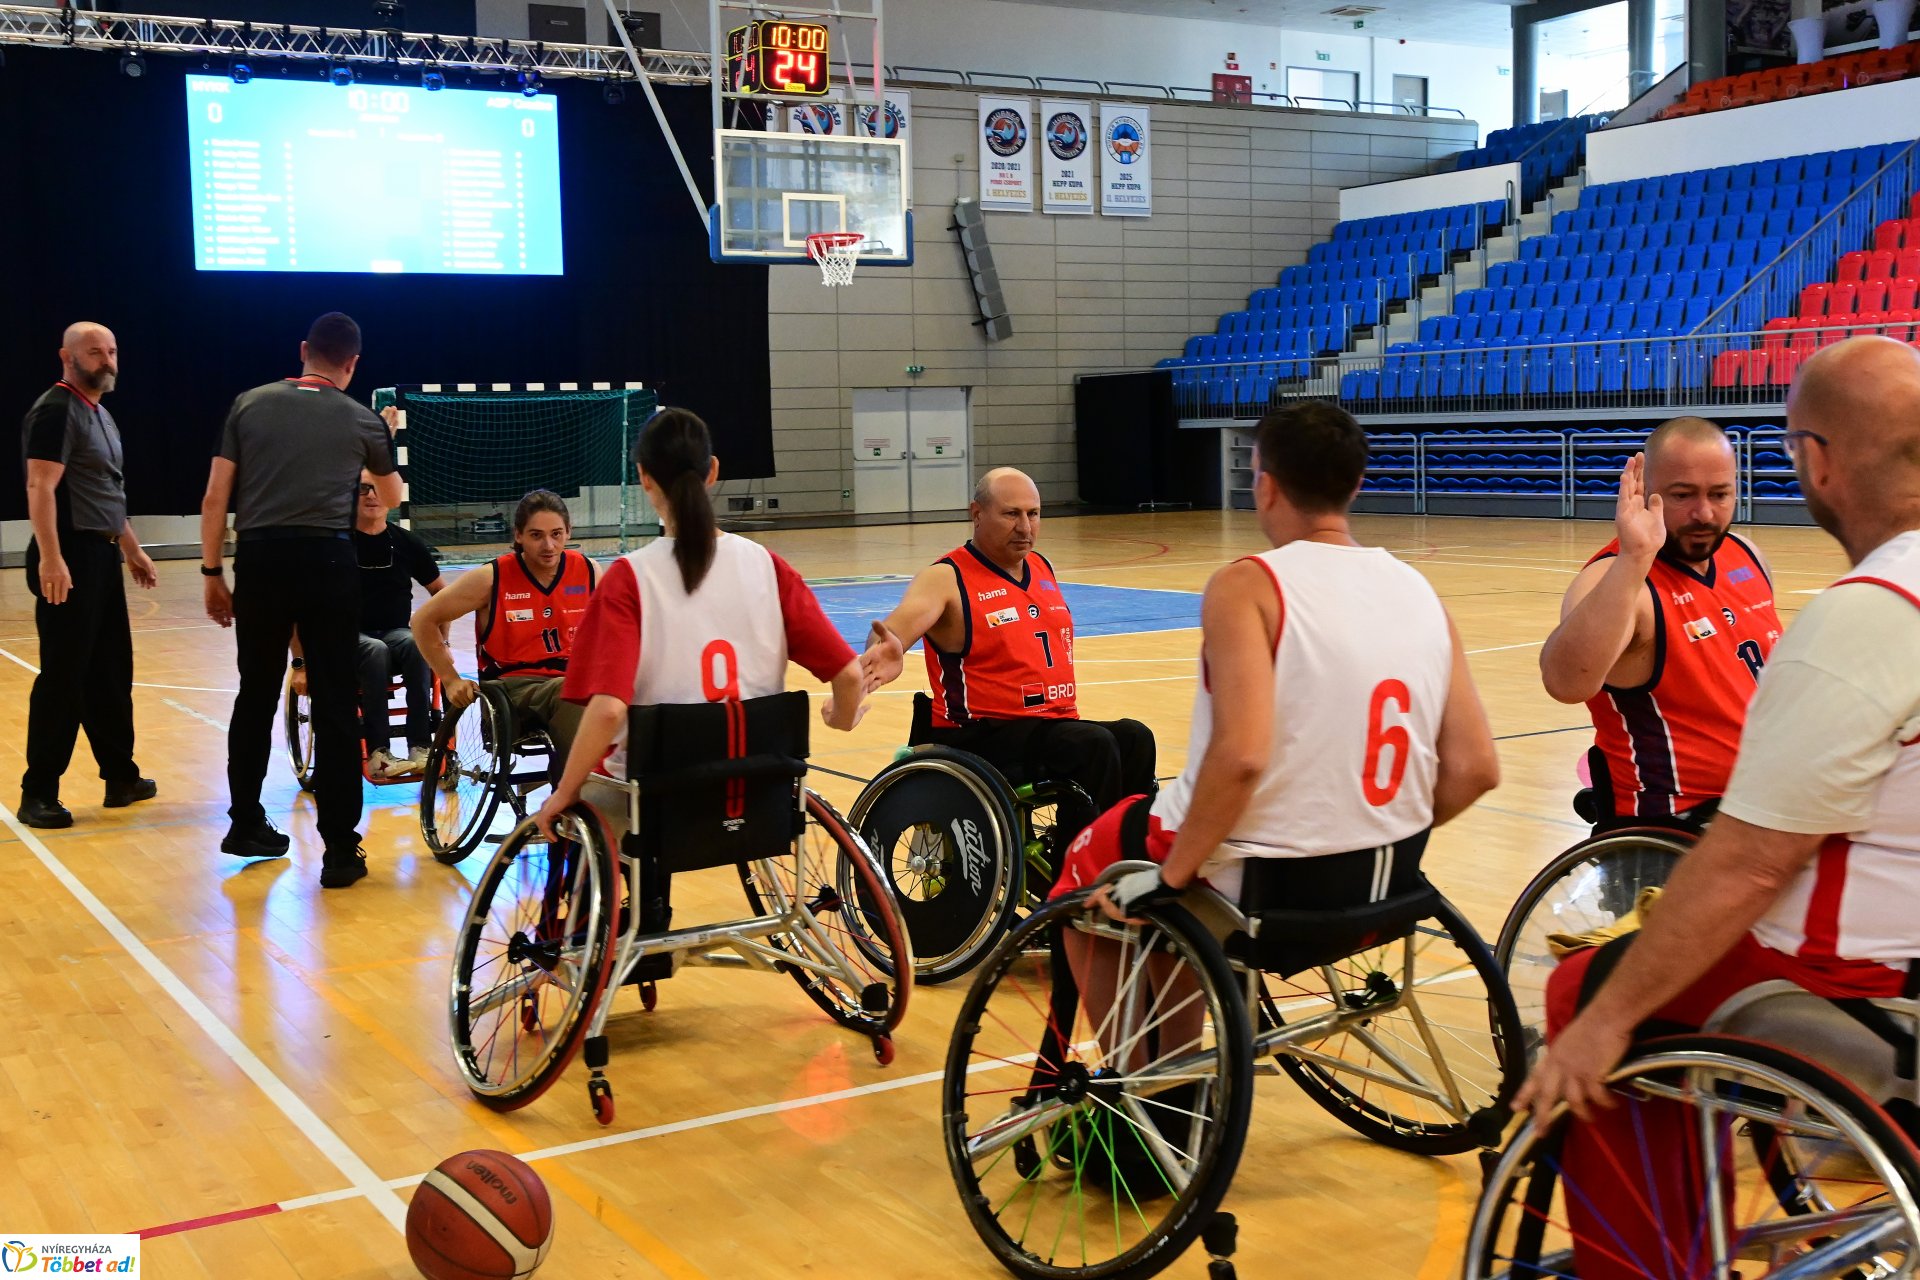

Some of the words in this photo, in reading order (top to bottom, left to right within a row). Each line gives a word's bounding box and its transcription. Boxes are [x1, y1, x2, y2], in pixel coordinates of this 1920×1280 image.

[771, 26, 825, 50] 10:00
[775, 50, 816, 84] 24
[208, 101, 223, 123] 0
[348, 90, 410, 113] 10:00
[521, 118, 535, 138] 0
[505, 592, 531, 600] hama
[977, 588, 1007, 602] hama
[541, 627, 563, 654] 11
[1034, 630, 1054, 668] 1
[701, 638, 741, 703] 9
[1047, 682, 1075, 700] BRD
[1362, 679, 1411, 807] 6
[466, 1160, 518, 1205] molten
